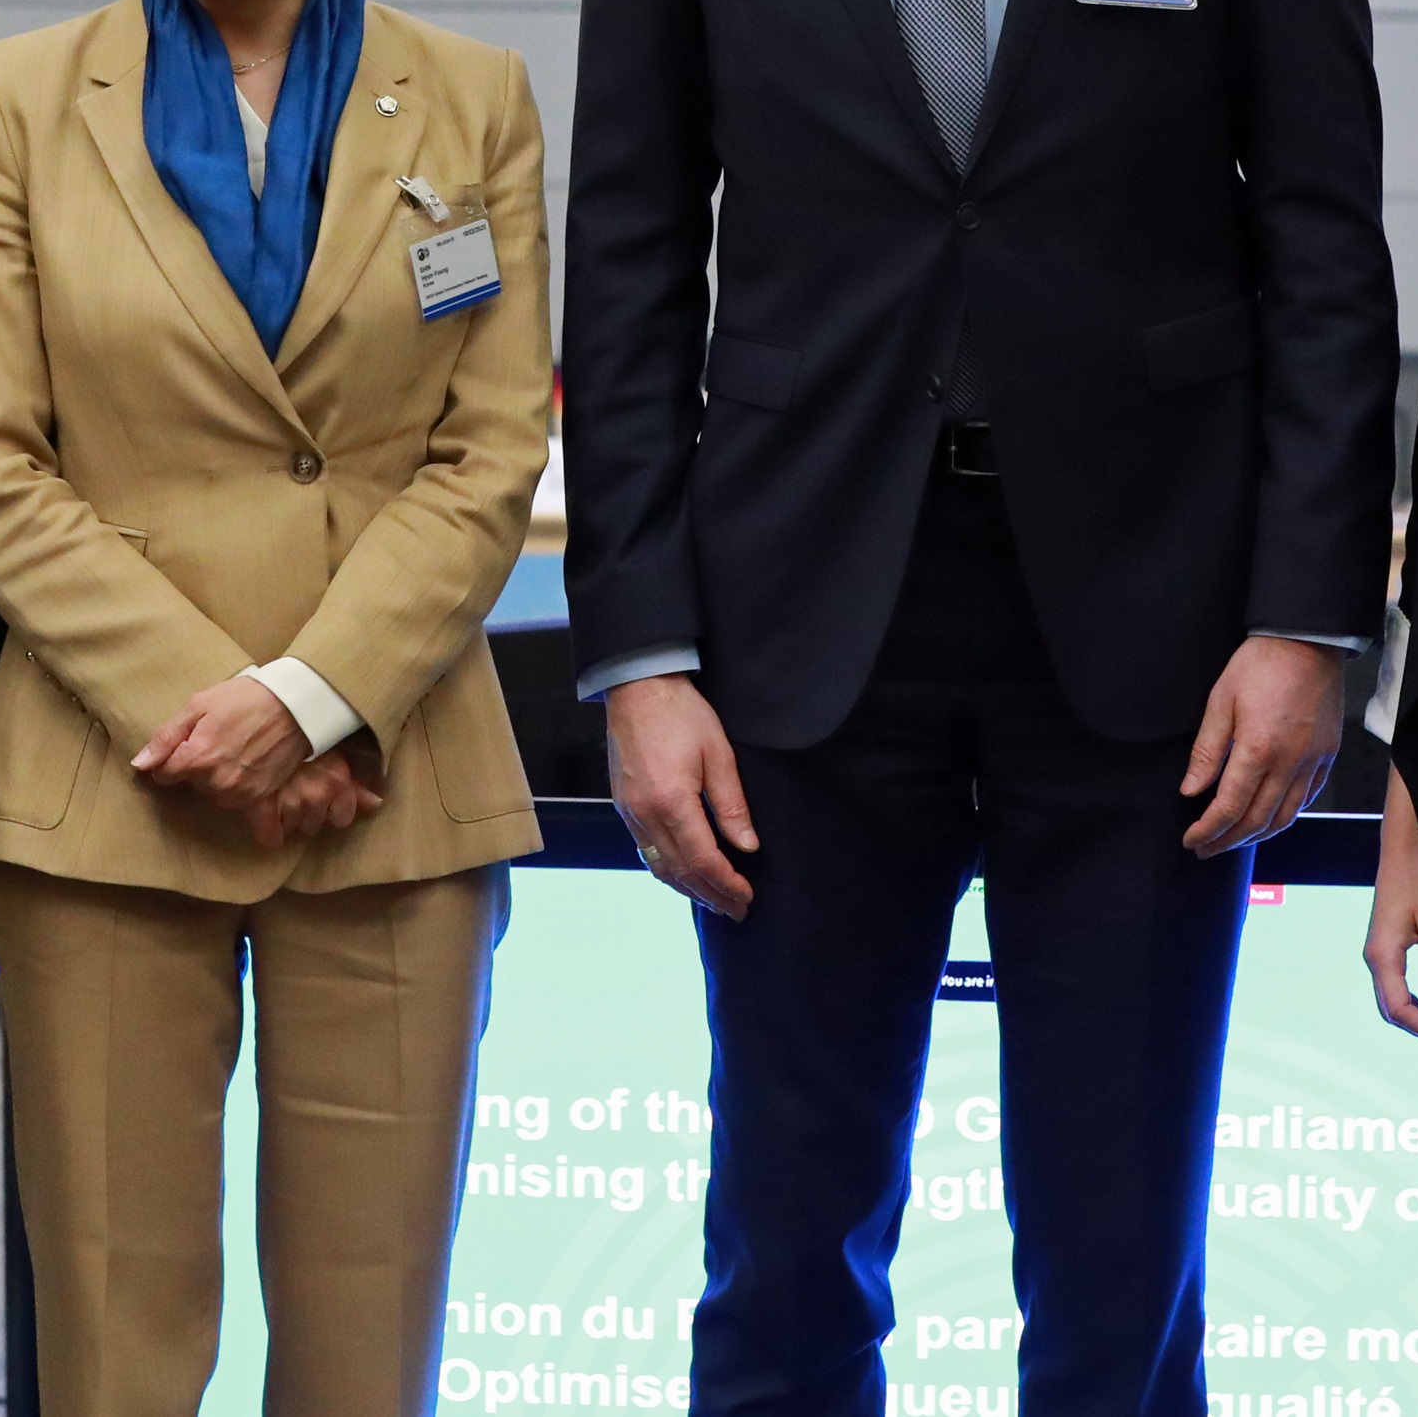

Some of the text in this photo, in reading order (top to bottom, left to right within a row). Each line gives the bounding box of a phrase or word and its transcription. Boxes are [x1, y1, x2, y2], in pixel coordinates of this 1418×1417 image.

[964, 976, 984, 988] are
[478, 1094, 549, 1141] ng
[569, 1087, 630, 1131] of
[1213, 1174, 1377, 1232] uality
[583, 1296, 655, 1340] du
